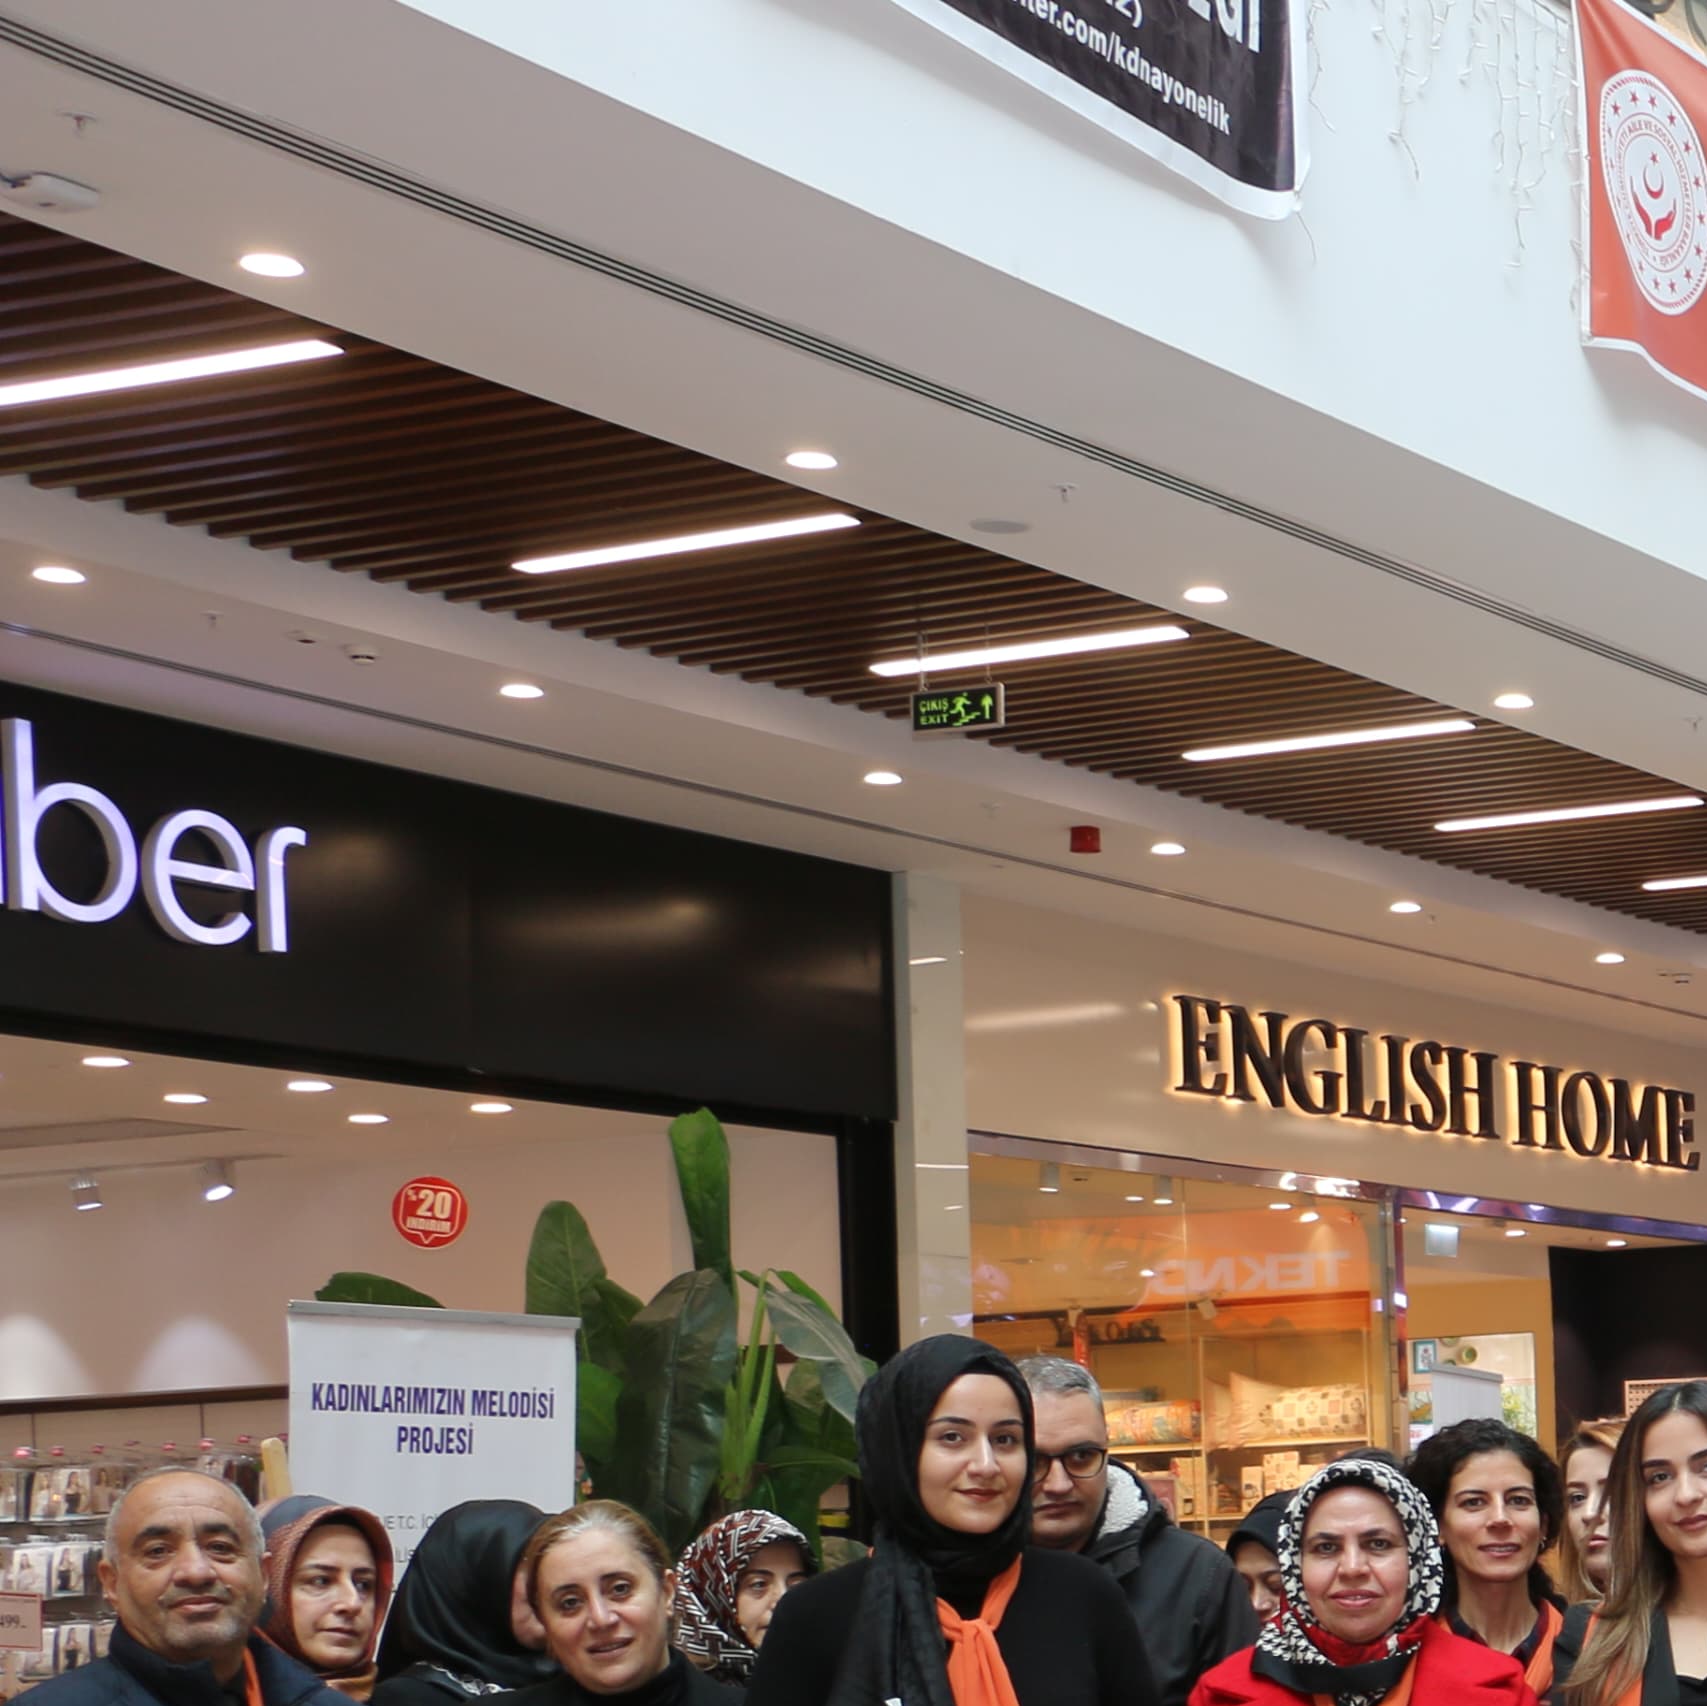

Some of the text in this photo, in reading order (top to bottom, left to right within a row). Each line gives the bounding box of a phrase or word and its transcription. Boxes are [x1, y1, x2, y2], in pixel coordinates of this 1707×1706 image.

[920, 714, 949, 725] EXIT
[1172, 994, 1701, 1173] ENGLISH HOME
[311, 1382, 555, 1420] KADINLARIMIZIN MELODİSİ
[396, 1422, 474, 1455] PROJESİ
